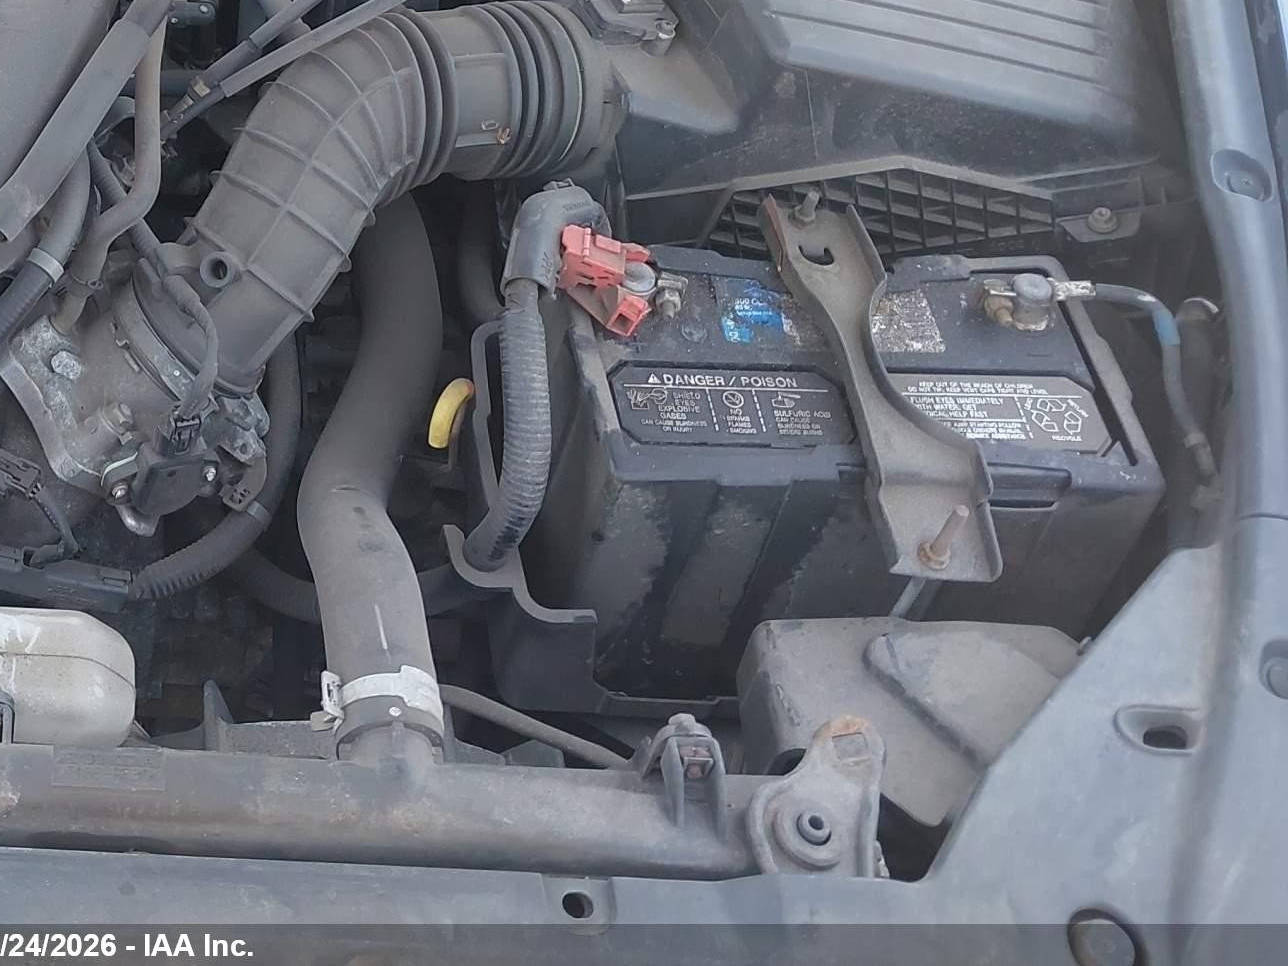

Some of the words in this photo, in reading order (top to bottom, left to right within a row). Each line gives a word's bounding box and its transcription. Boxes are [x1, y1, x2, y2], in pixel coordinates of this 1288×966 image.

[663, 373, 726, 387] DANGER
[740, 376, 798, 388] POISON
[957, 397, 1004, 405] IMMEDIATELY
[658, 405, 701, 413] EXPLOSIVE
[659, 412, 687, 420] GASES
[774, 410, 811, 418] SULFURIC
